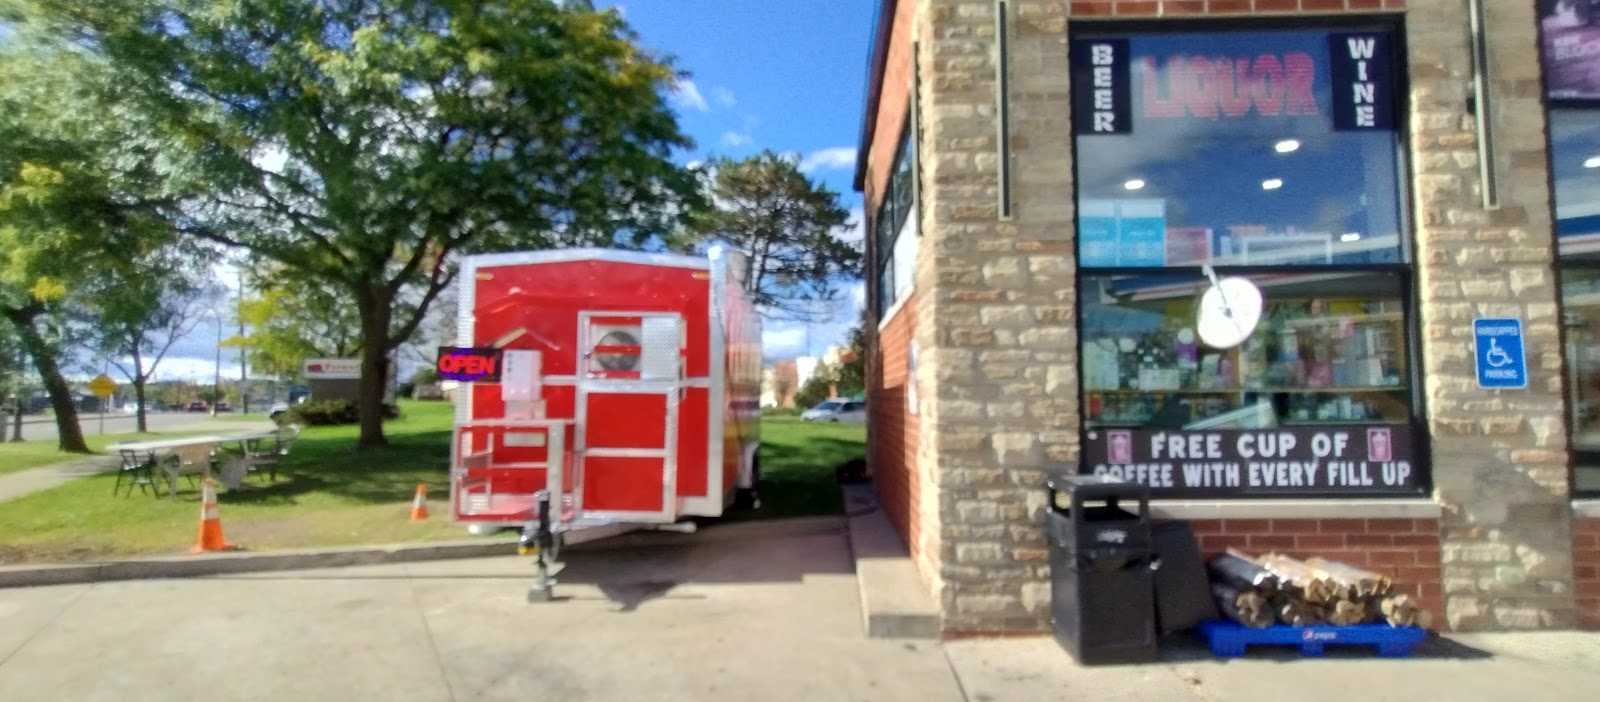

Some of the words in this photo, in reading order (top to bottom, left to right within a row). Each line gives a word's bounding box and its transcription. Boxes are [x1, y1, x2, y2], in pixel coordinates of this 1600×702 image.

[1091, 44, 1114, 132] BEER
[1142, 53, 1318, 119] LIQUOR
[1348, 38, 1375, 127] WINE
[439, 354, 495, 374] OPEN
[1485, 369, 1517, 379] PARKING
[1151, 432, 1223, 459] FREE
[1237, 433, 1297, 458] CUP
[1311, 433, 1349, 458] OF
[1183, 463, 1240, 488] WITH
[1250, 462, 1318, 487] EVERY
[1327, 462, 1373, 487] FILL
[1382, 462, 1411, 486] UP
